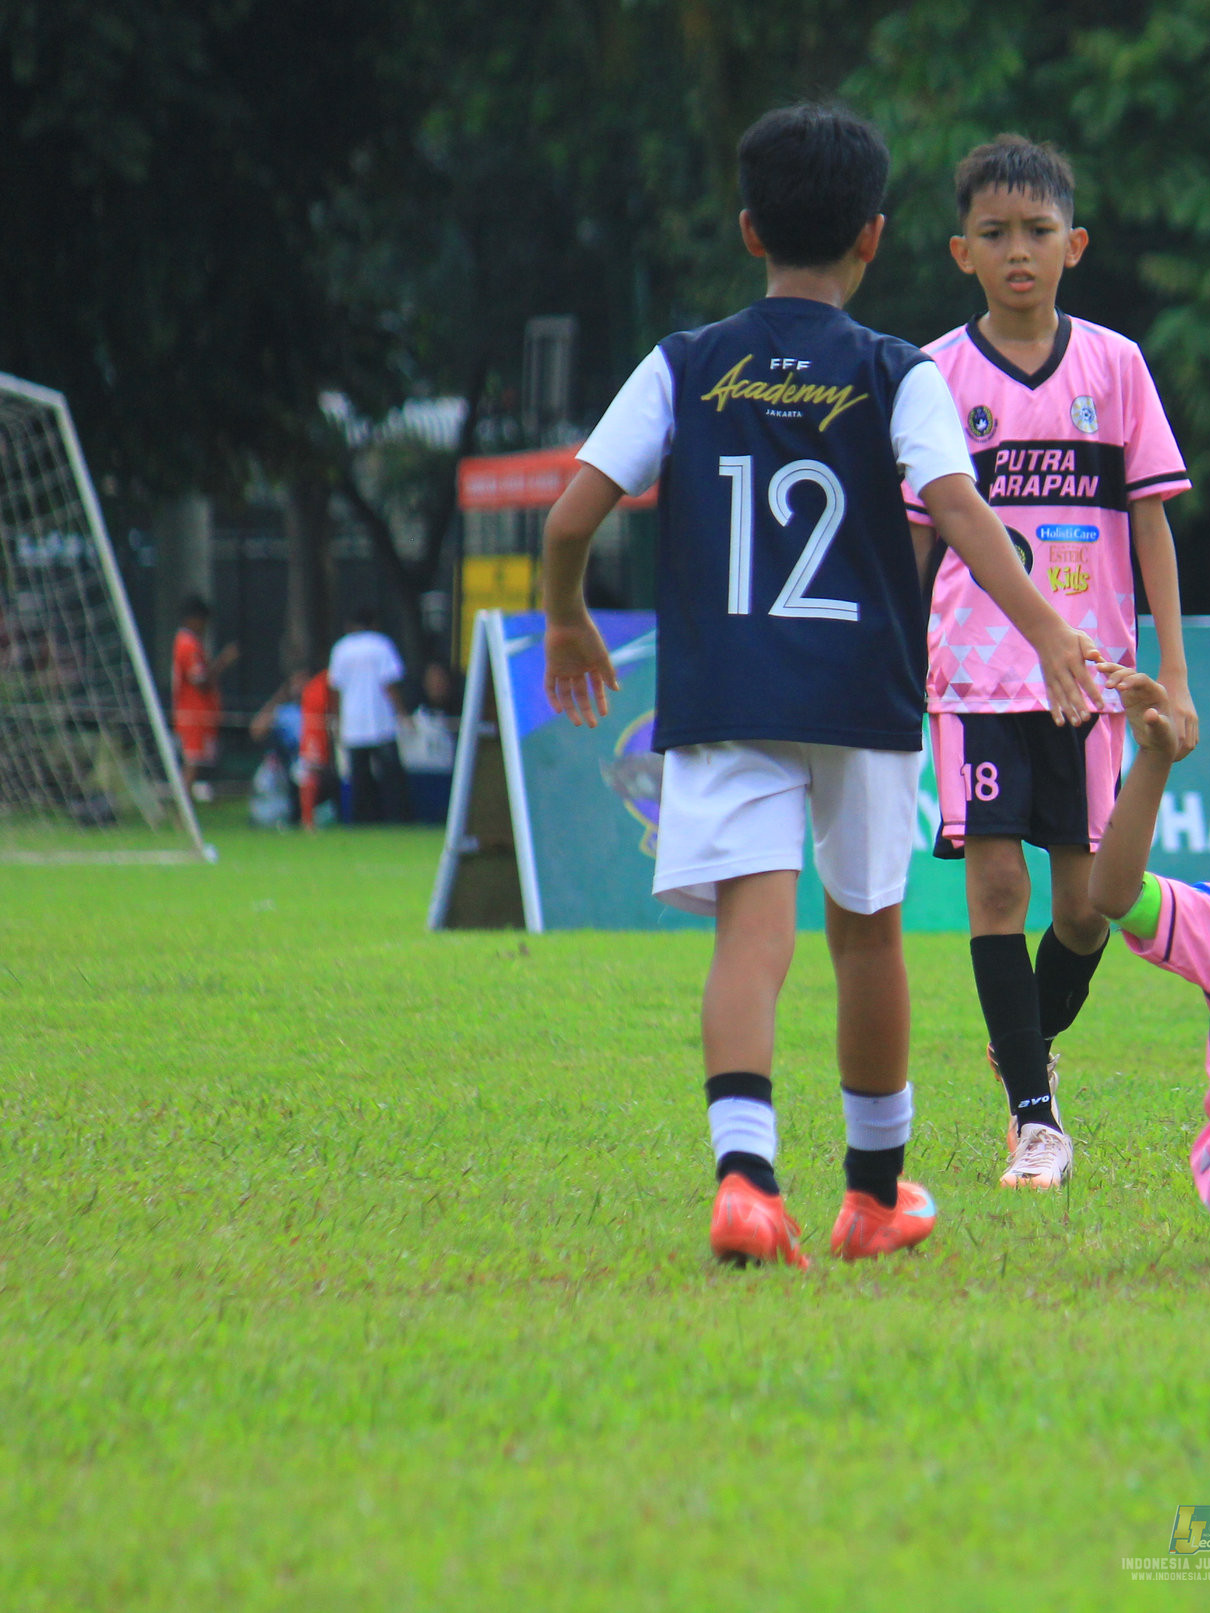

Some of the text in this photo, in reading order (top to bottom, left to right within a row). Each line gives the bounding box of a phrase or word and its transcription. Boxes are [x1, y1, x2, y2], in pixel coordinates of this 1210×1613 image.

[770, 358, 812, 370] FFF
[701, 354, 869, 432] Academy
[765, 409, 803, 418] JAKARTA
[995, 449, 1075, 472] PUTRA
[989, 475, 1099, 504] ARAPAN
[719, 455, 859, 621] 12
[1040, 527, 1097, 539] HolistiCare
[1047, 564, 1090, 596] Kids
[961, 762, 1000, 801] 18
